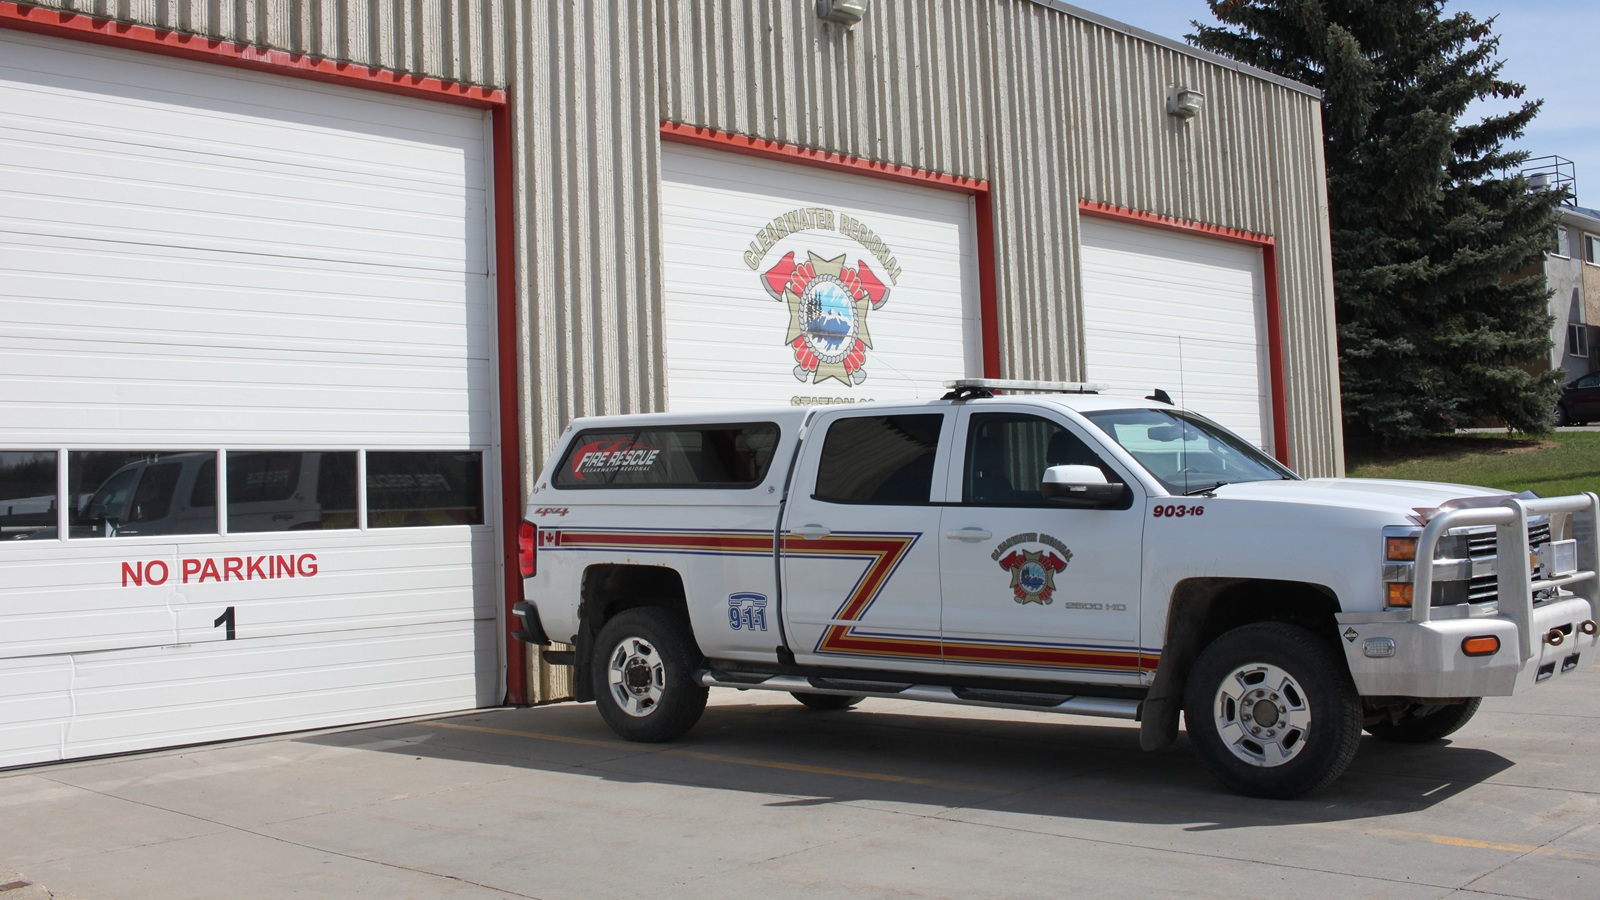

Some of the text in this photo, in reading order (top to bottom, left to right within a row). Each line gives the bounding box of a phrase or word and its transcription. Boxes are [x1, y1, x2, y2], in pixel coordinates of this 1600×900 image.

[743, 207, 903, 286] CLEARWATER REGIONAL
[575, 449, 661, 473] FIRE RESCUE
[1153, 504, 1205, 518] 903-16
[121, 553, 319, 587] NO PARKING
[1065, 602, 1127, 611] 2500 HD
[213, 606, 236, 641] 1
